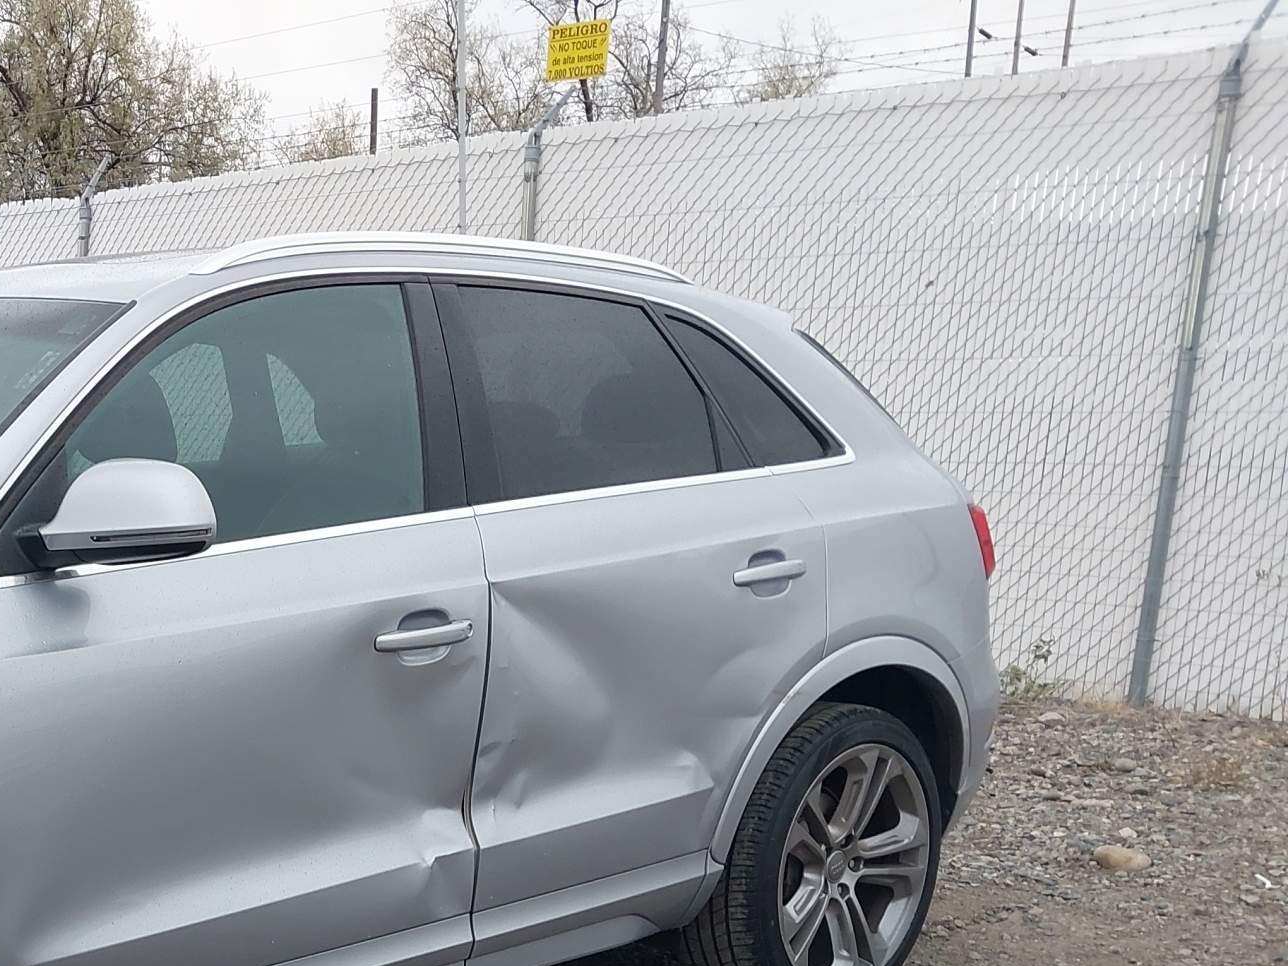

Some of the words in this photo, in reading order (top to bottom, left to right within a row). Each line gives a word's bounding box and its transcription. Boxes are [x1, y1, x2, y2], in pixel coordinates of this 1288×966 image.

[552, 22, 608, 39] PELIGRO
[558, 43, 570, 53] NO
[572, 39, 598, 50] TOQUE
[552, 57, 560, 66] de
[562, 55, 575, 65] alta
[568, 63, 605, 77] VOLTIOS
